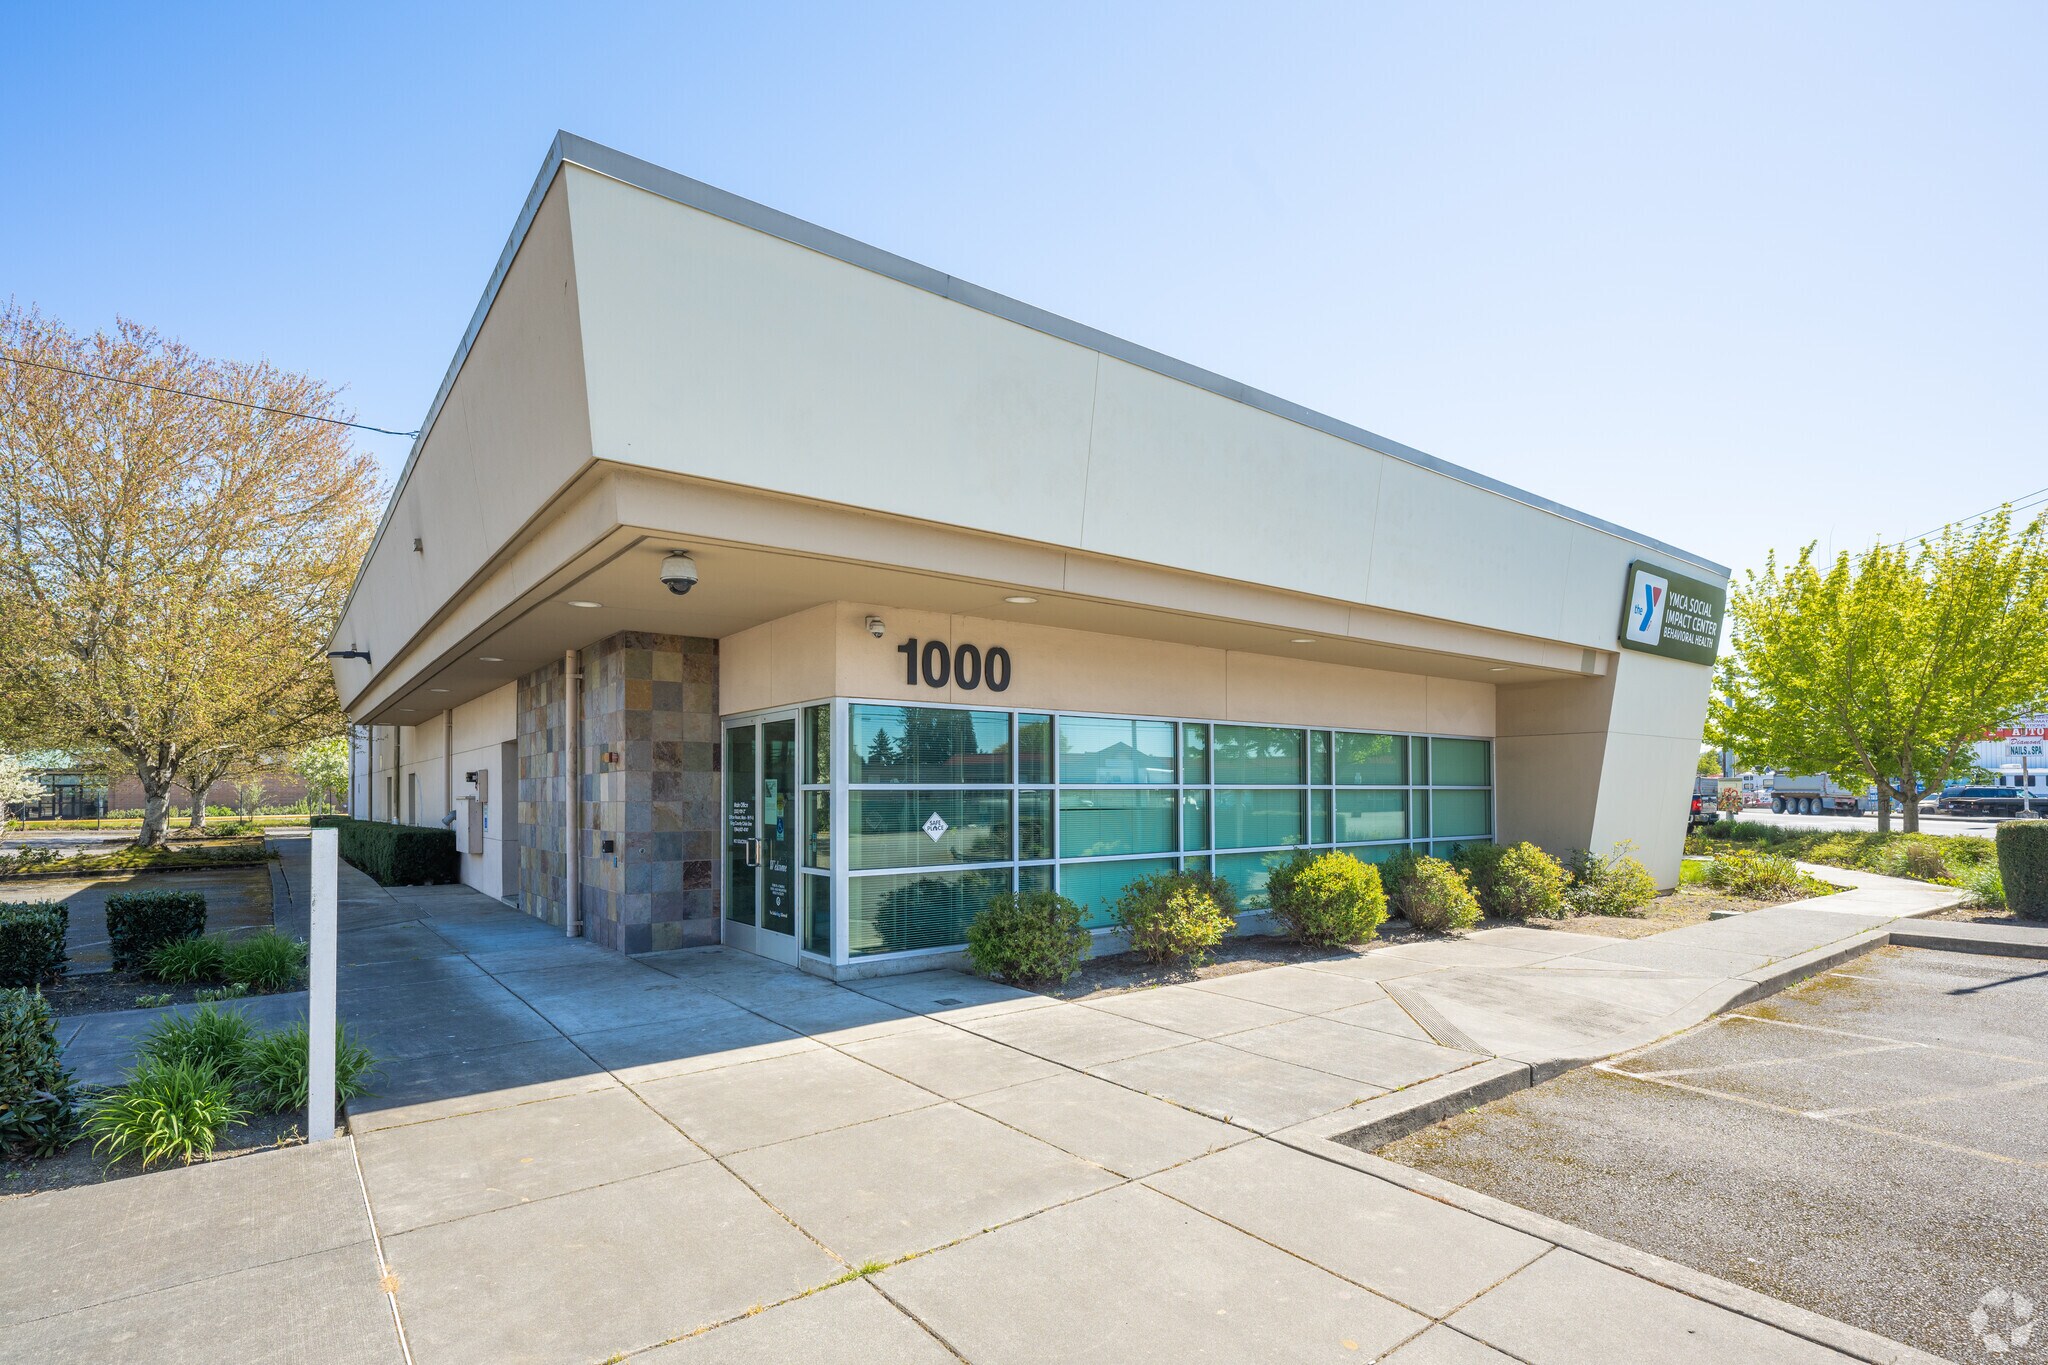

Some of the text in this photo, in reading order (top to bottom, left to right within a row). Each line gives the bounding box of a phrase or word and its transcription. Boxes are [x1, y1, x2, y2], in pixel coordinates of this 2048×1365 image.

[1634, 603, 1643, 616] the
[1669, 591, 1712, 617] YMCA SOCIAL
[1665, 609, 1691, 629] IMPACT
[1692, 617, 1718, 636] CENTER
[1663, 628, 1714, 648] BEHAVIORAL HEALTH
[897, 638, 1011, 692] 1000
[2010, 746, 2027, 755] NAILS
[2032, 746, 2042, 755] SPA
